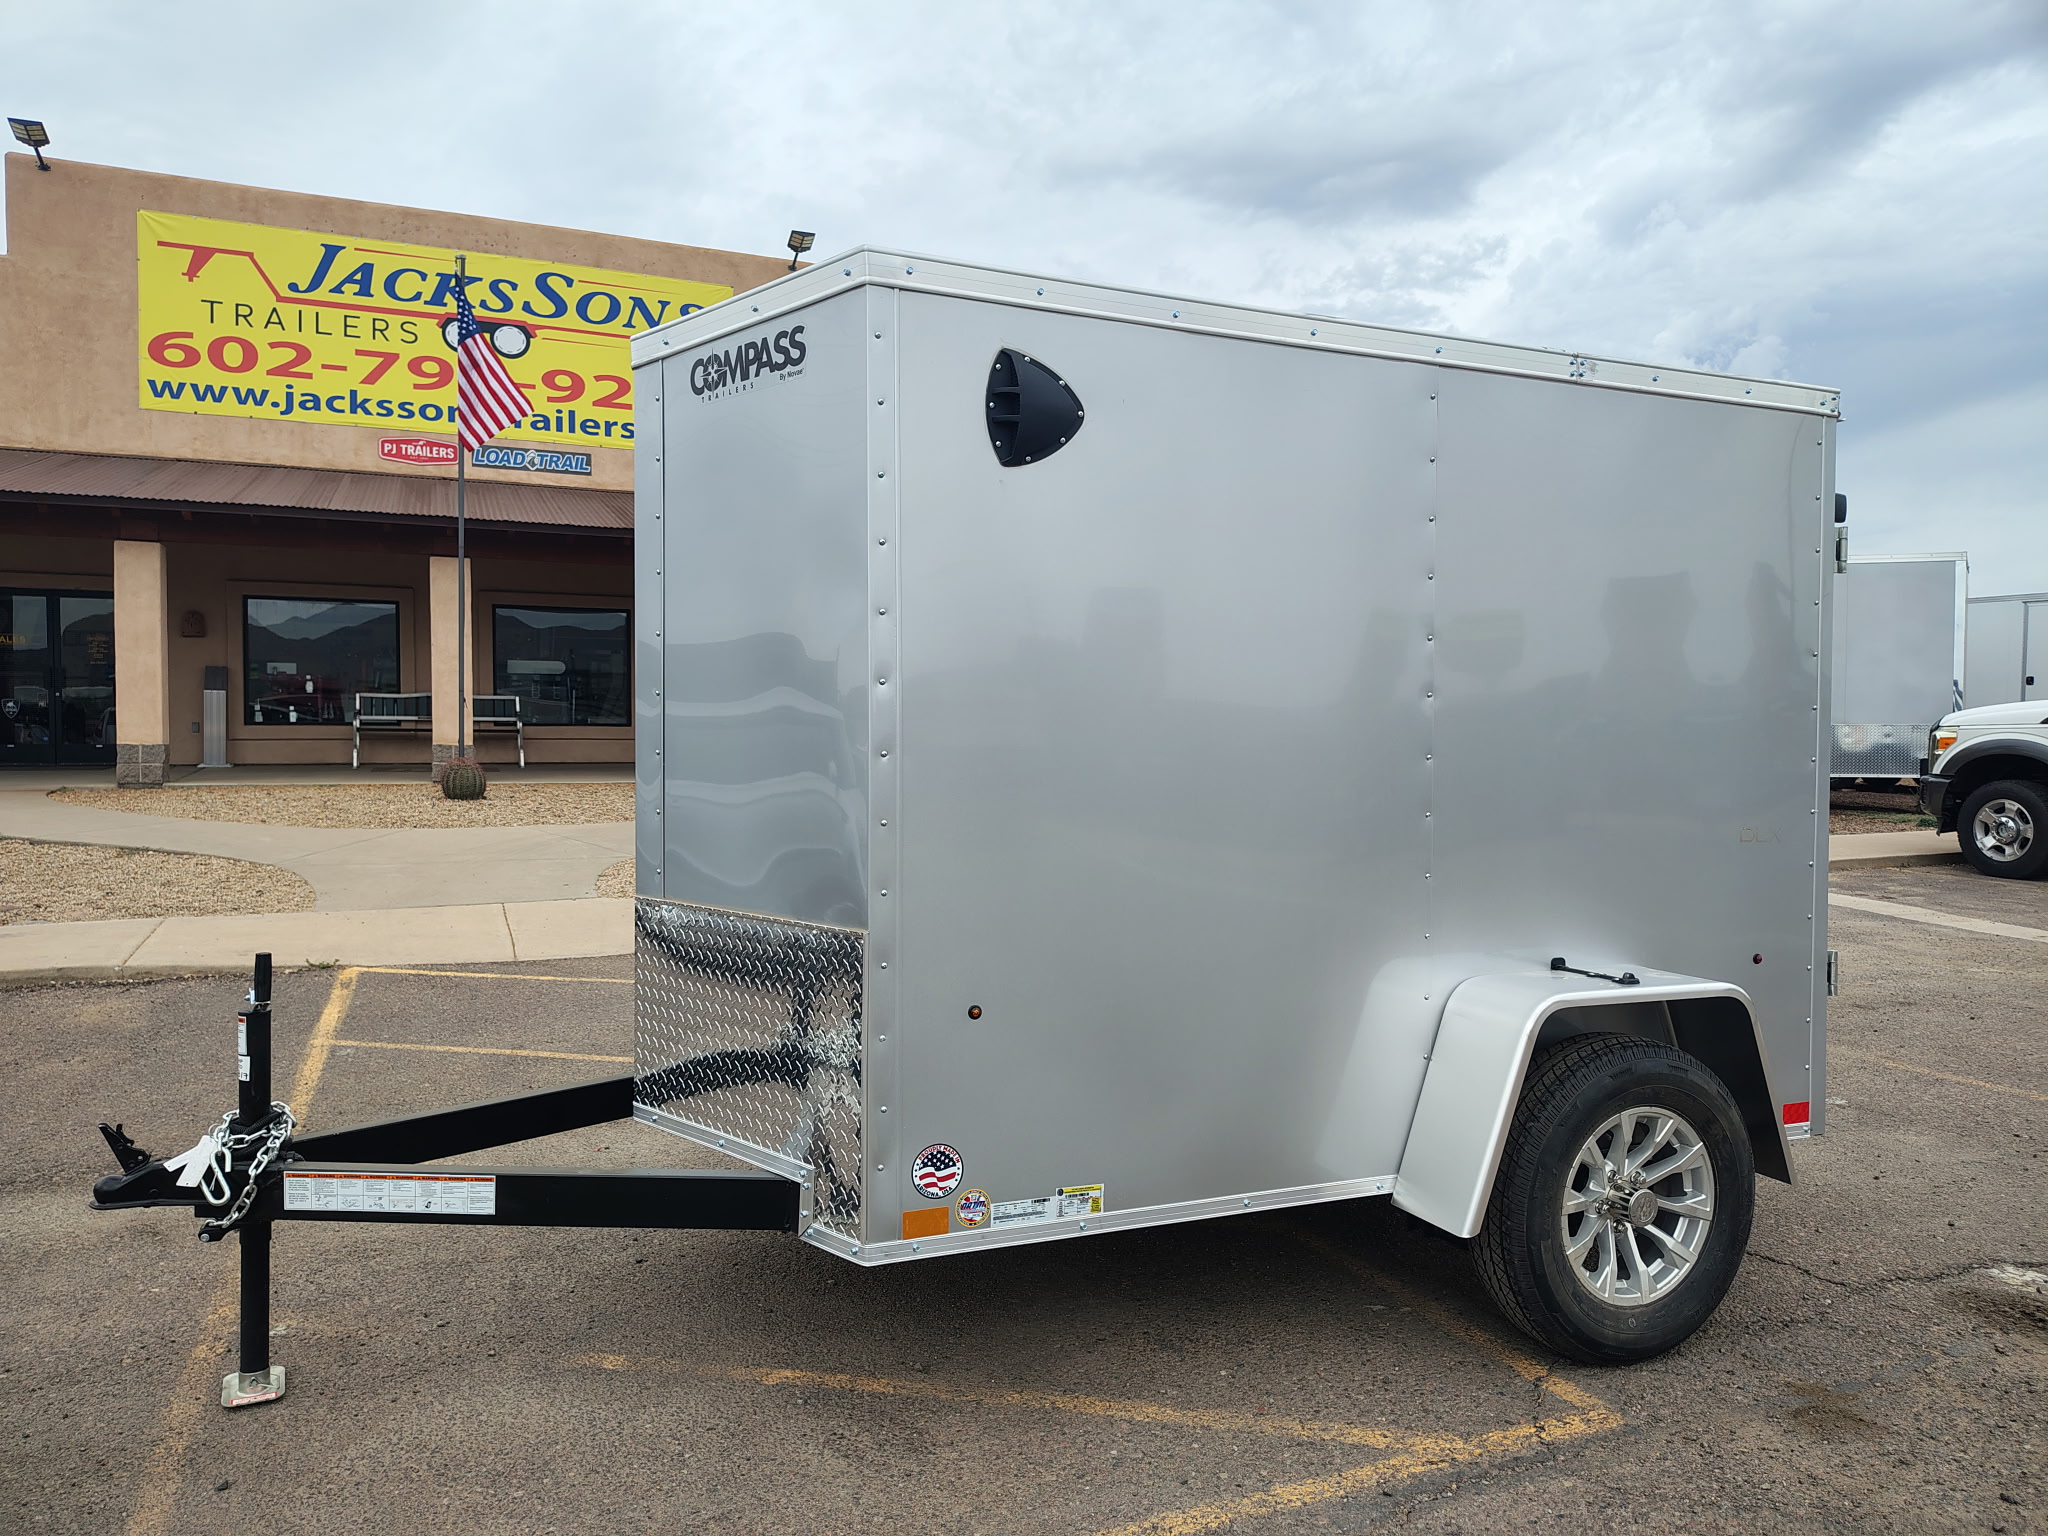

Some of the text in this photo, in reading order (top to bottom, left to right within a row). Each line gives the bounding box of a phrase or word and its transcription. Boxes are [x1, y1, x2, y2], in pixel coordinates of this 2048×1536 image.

[201, 299, 418, 344] TRAILERS
[147, 331, 633, 411] 602-79-92
[690, 325, 806, 396] COMPASS
[779, 373, 787, 381] By
[702, 382, 754, 403] TRAILERS
[384, 442, 455, 459] PJ TRAILERS
[473, 447, 591, 472] LOAD TRAIL
[918, 1145, 943, 1161] PROUDLY
[943, 1146, 957, 1157] MADE
[941, 1186, 953, 1196] USA
